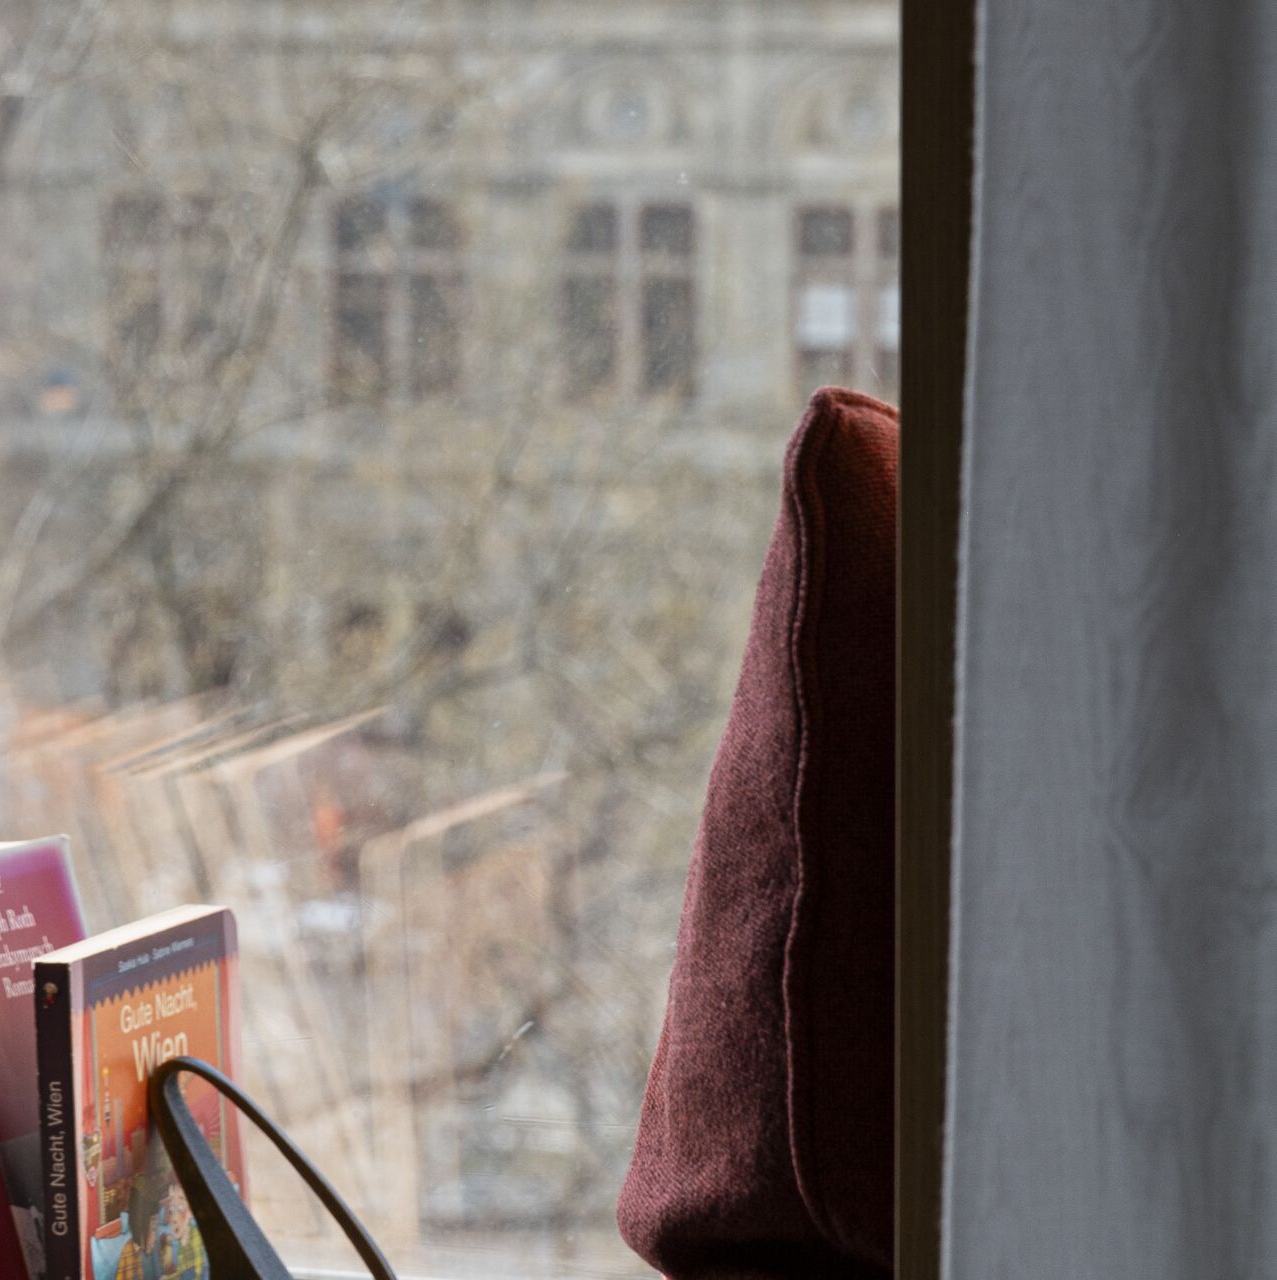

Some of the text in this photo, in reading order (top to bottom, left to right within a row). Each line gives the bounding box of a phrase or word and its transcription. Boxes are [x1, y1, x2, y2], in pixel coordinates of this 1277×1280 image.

[5, 905, 36, 931] Roth
[120, 983, 197, 1034] Gute Nacht,
[132, 1031, 188, 1082] Wien
[47, 1081, 68, 1236] Gute Nacht, Wien
